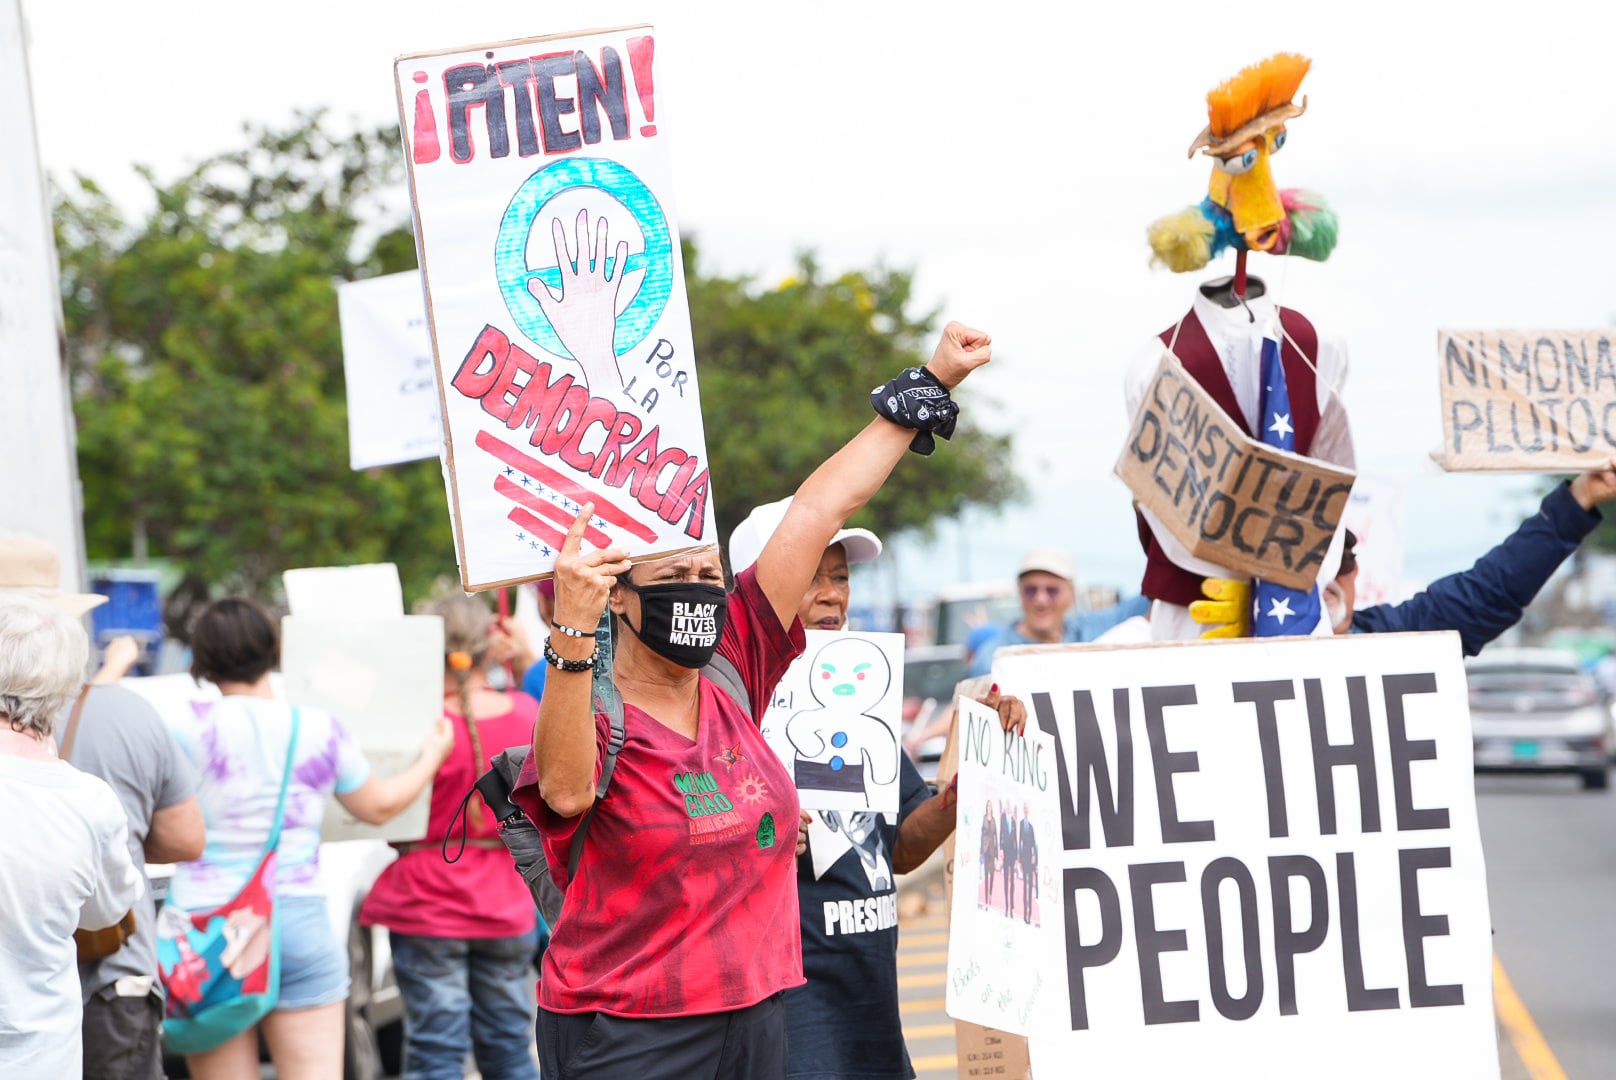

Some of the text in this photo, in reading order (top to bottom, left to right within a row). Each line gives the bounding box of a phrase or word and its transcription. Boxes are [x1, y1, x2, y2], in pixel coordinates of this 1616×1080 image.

[622, 376, 660, 414] LA
[645, 338, 689, 398] POR
[451, 323, 711, 541] DEMOCRACIA
[673, 602, 718, 618] BLACK
[673, 617, 715, 633] LIVES
[670, 631, 717, 647] MATTER
[964, 711, 992, 767] NO
[1031, 672, 1451, 850] WE THE
[1063, 846, 1466, 1032] PEOPLE
